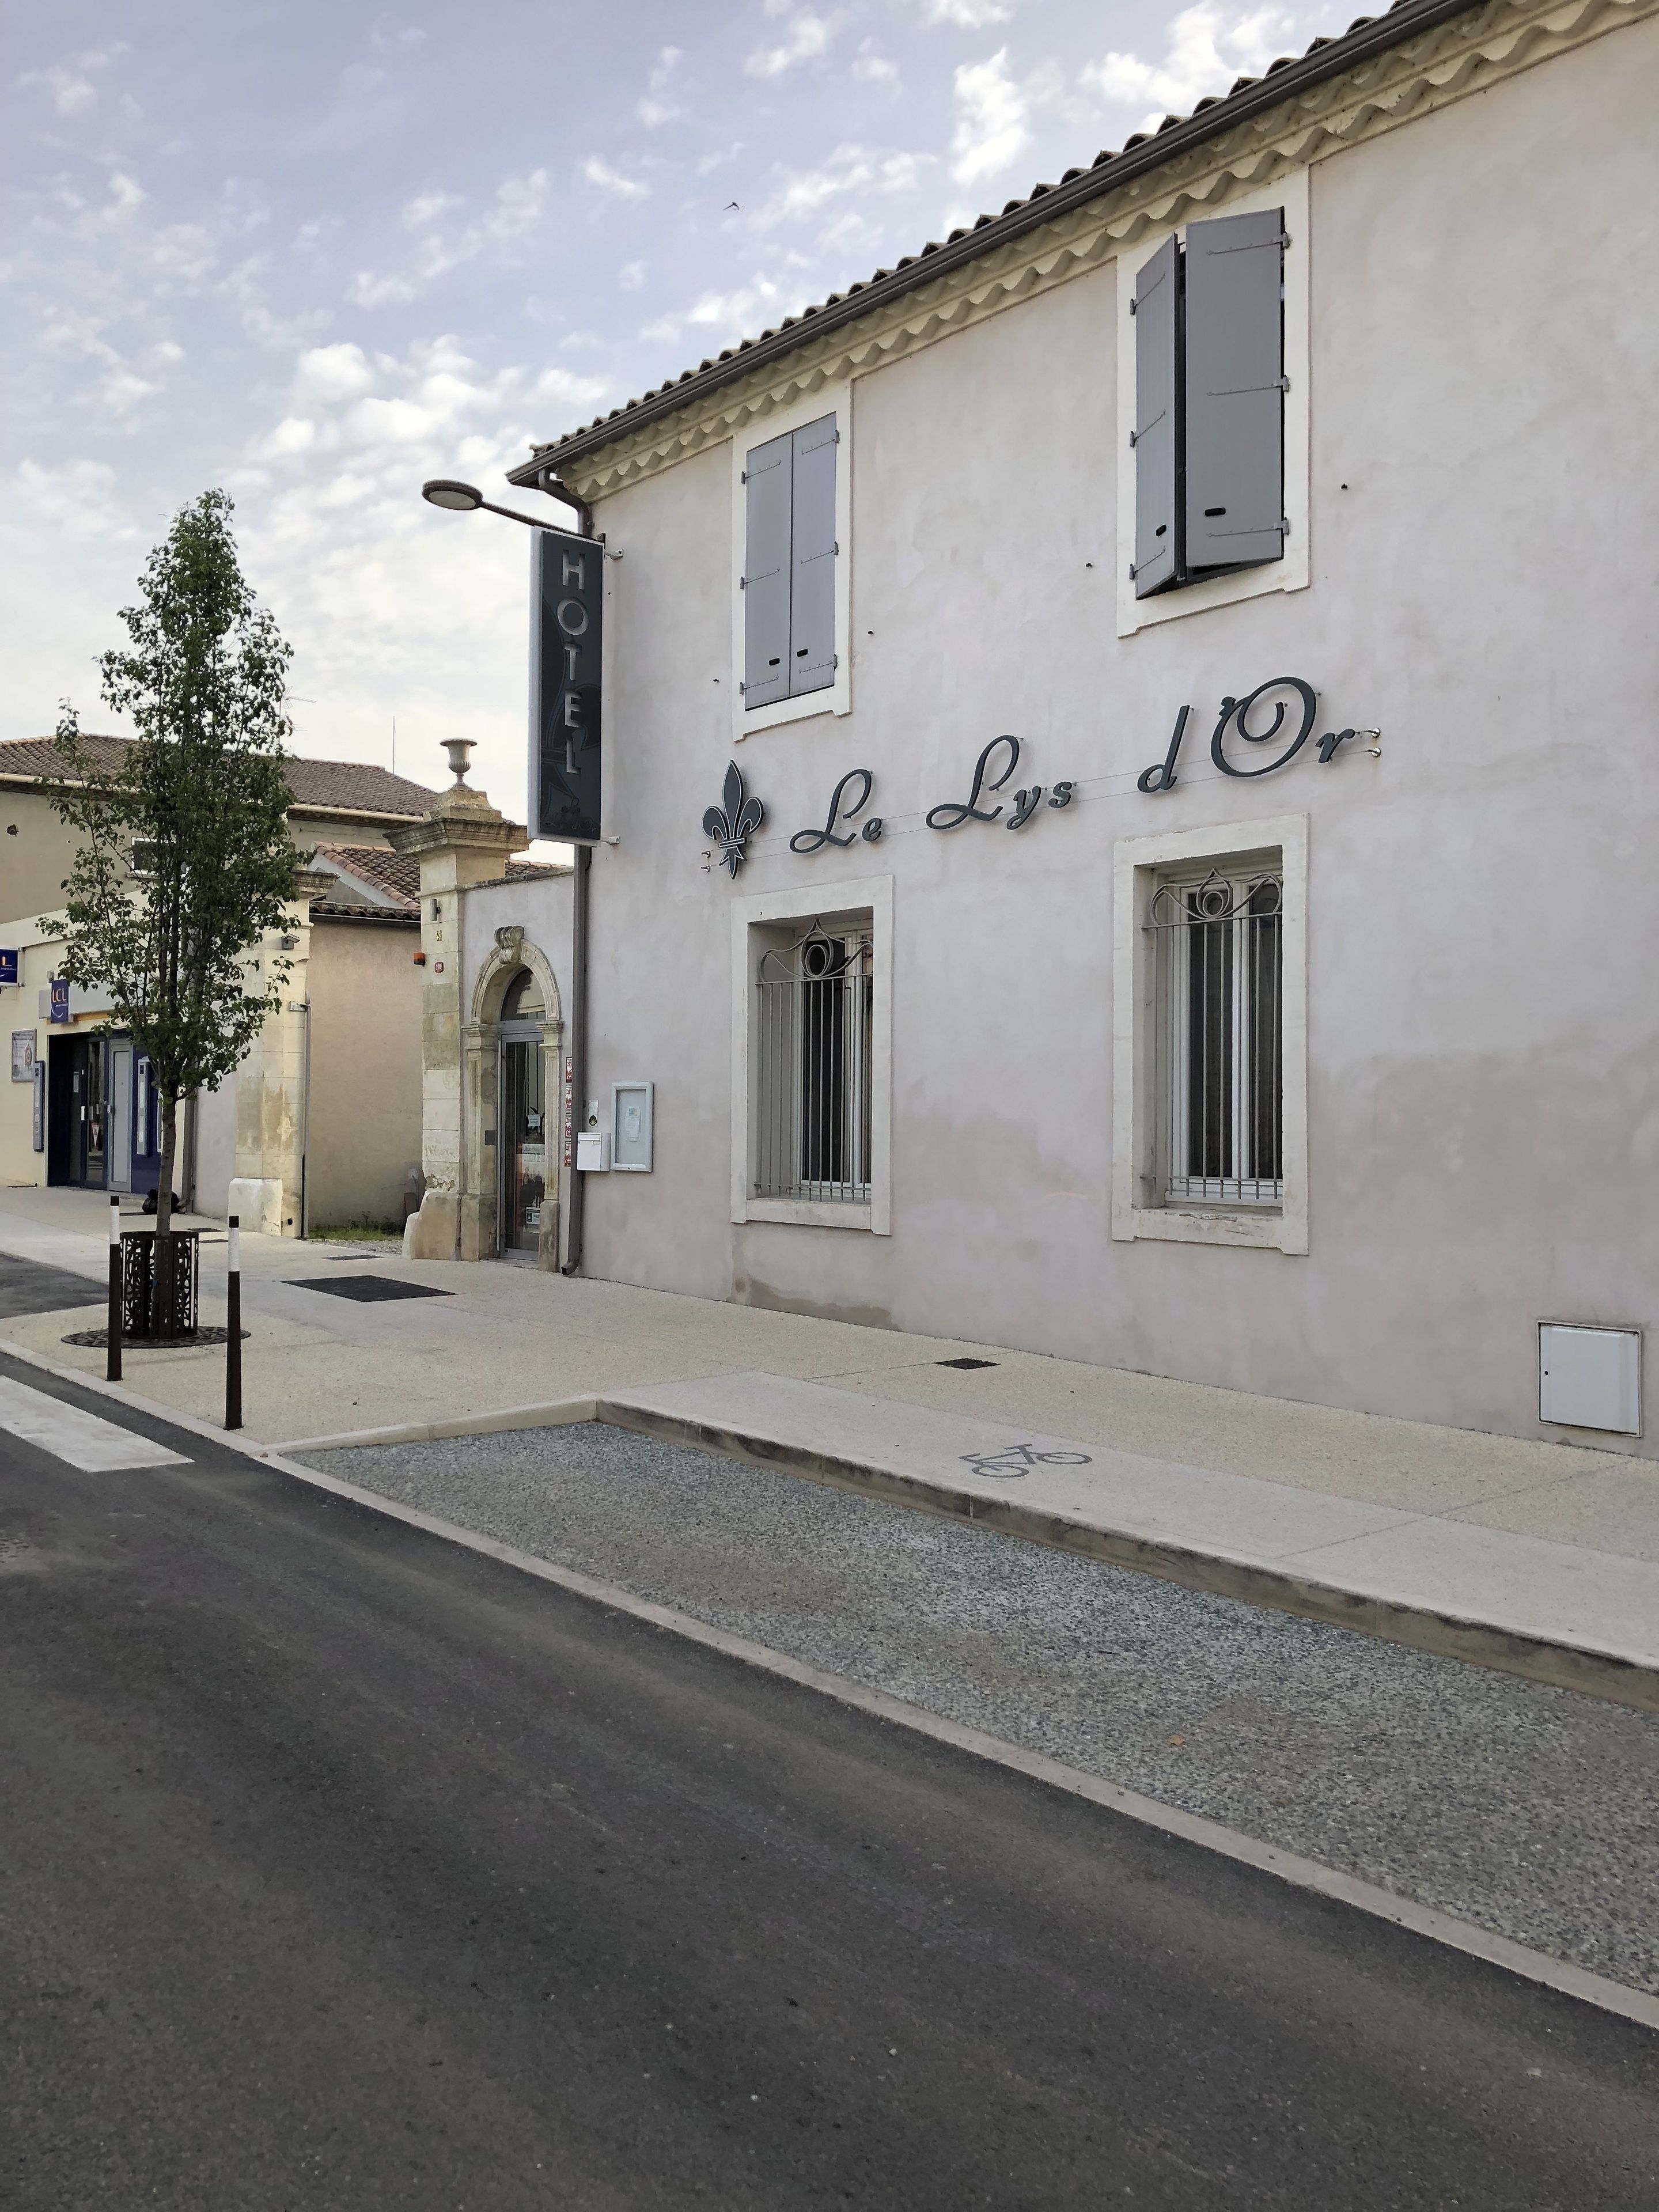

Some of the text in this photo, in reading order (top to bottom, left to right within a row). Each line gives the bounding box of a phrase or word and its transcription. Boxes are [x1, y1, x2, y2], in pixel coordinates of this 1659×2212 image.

[556, 548, 590, 775] HOTEL
[789, 676, 1356, 854] Le Lys d'Or
[52, 987, 67, 1002] LCL
